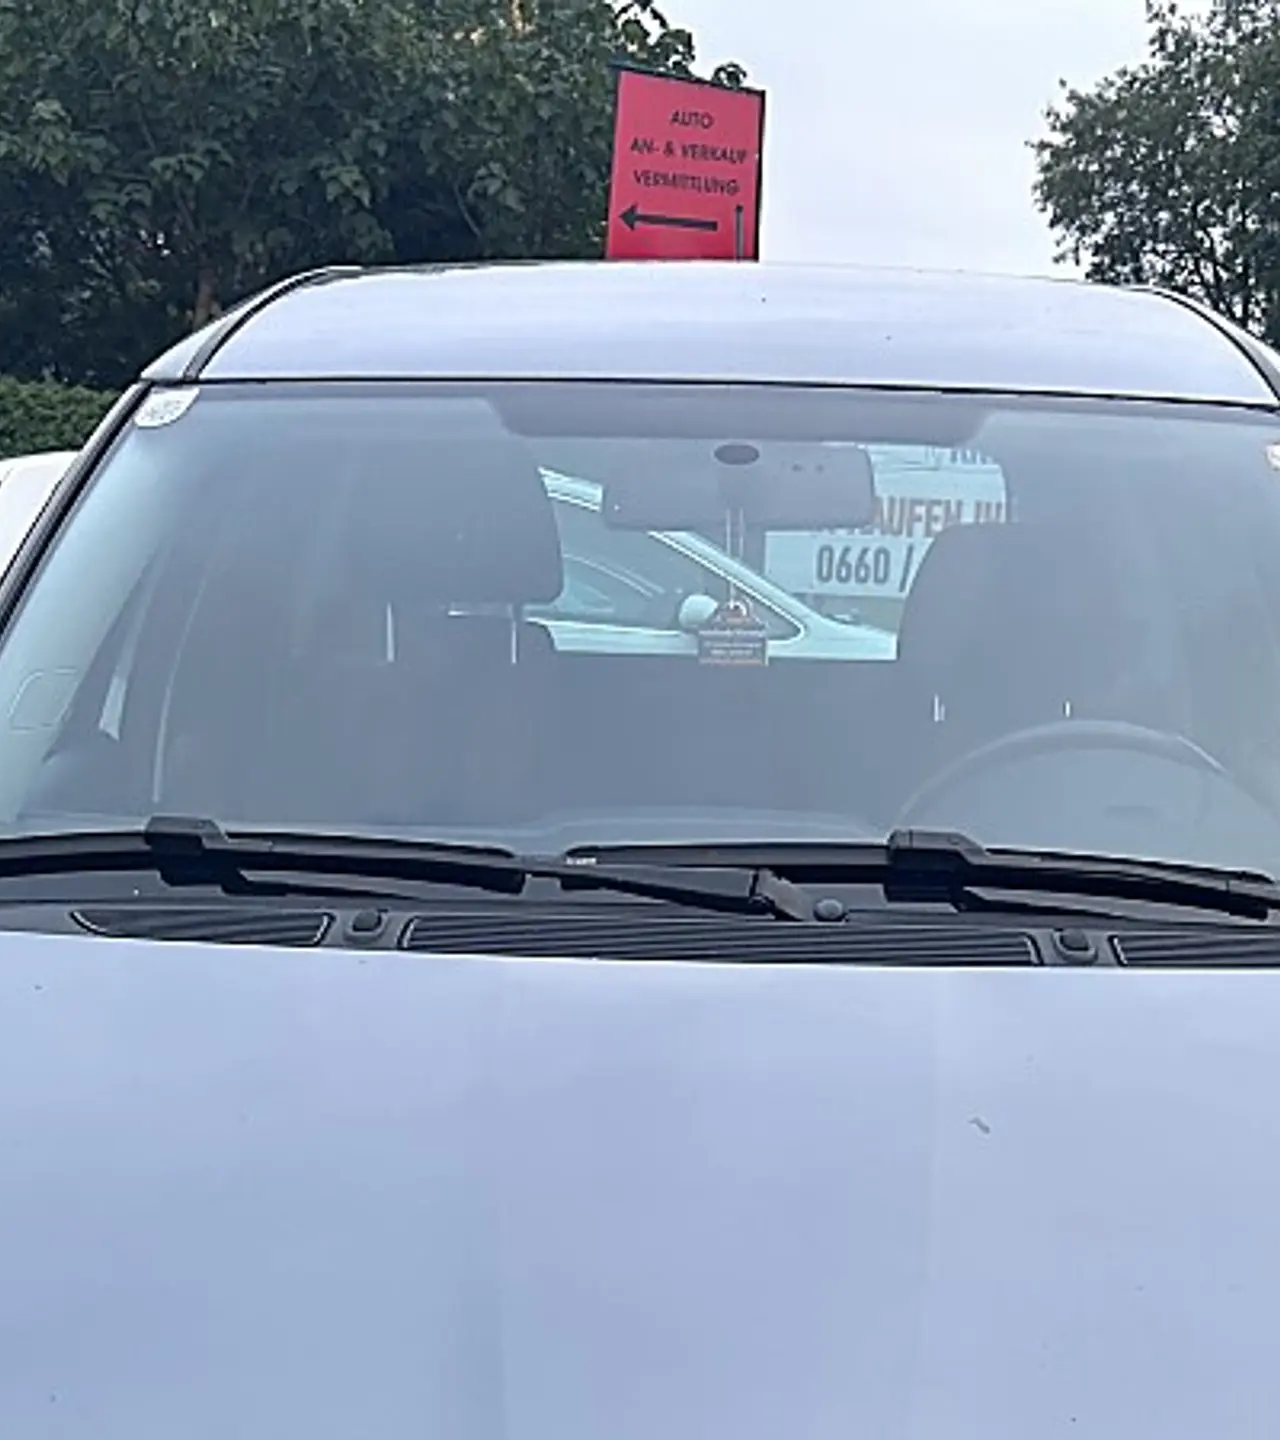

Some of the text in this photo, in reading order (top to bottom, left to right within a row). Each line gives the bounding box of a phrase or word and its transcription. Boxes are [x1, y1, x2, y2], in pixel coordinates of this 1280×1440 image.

[670, 110, 715, 129] AUTO
[681, 144, 748, 165] VERKAUF
[633, 169, 741, 196] VERMITTLUNG
[816, 543, 891, 585] 0660
